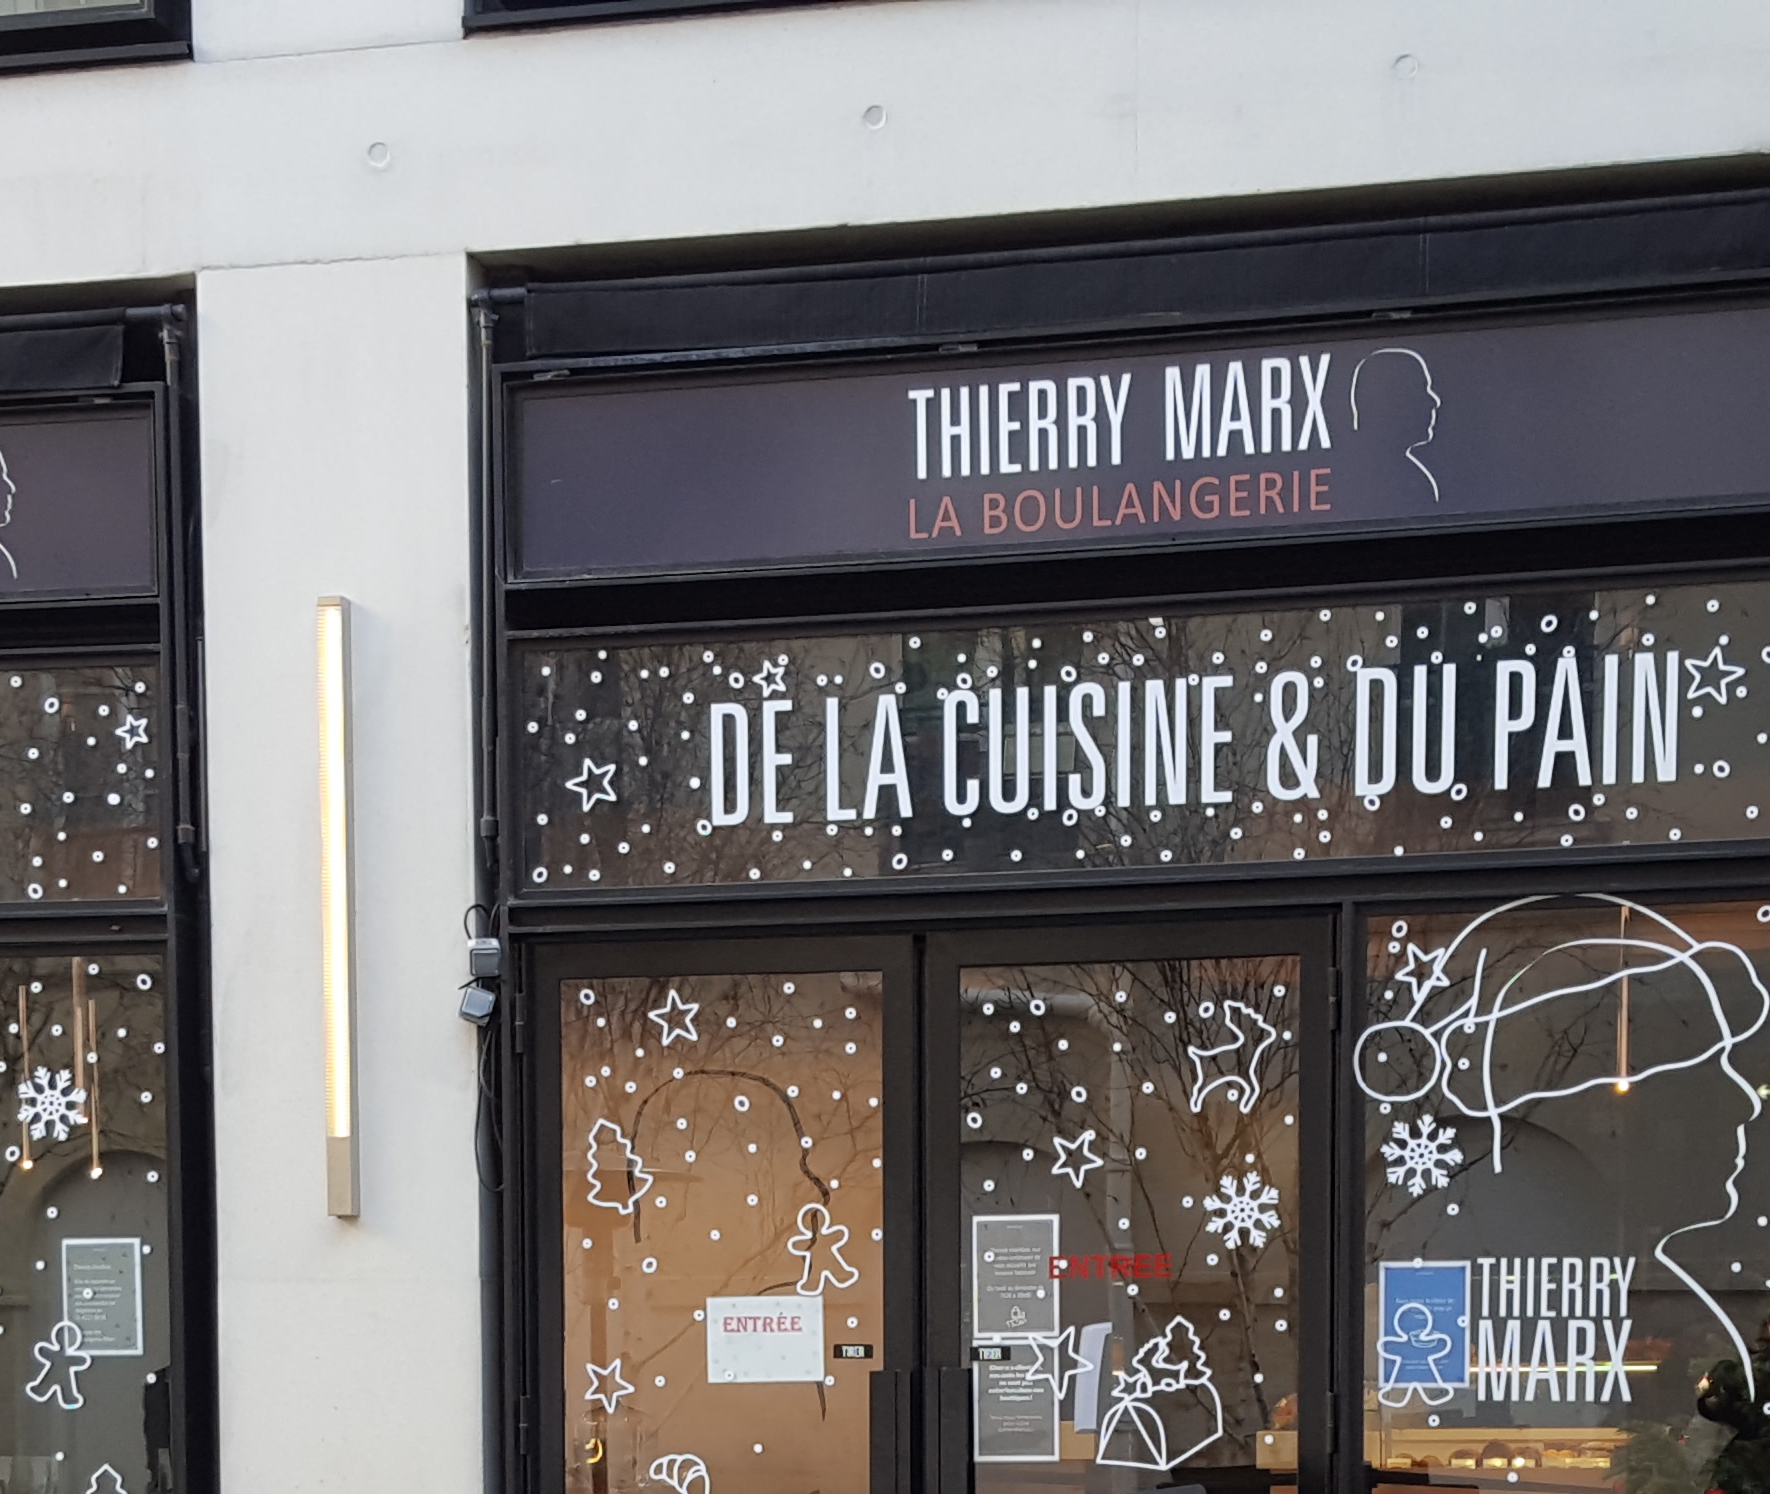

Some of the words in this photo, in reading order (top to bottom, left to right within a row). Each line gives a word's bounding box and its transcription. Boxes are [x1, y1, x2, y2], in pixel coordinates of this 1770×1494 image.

[908, 373, 1131, 480] THIERRY
[1164, 352, 1331, 462] MARX
[909, 496, 963, 540] LA
[982, 468, 1332, 536] BOULANGERIE
[709, 697, 795, 827] DE
[824, 692, 914, 822] LA
[941, 675, 1233, 817] CUISINE
[1265, 670, 1321, 802] &
[1353, 662, 1458, 798] DU
[1493, 650, 1680, 791] PAIN
[1048, 1253, 1173, 1280] ENTREE
[1476, 1256, 1637, 1318] THIERRY
[722, 1311, 804, 1333] ENTRÉE
[1478, 1319, 1633, 1402] MARX
